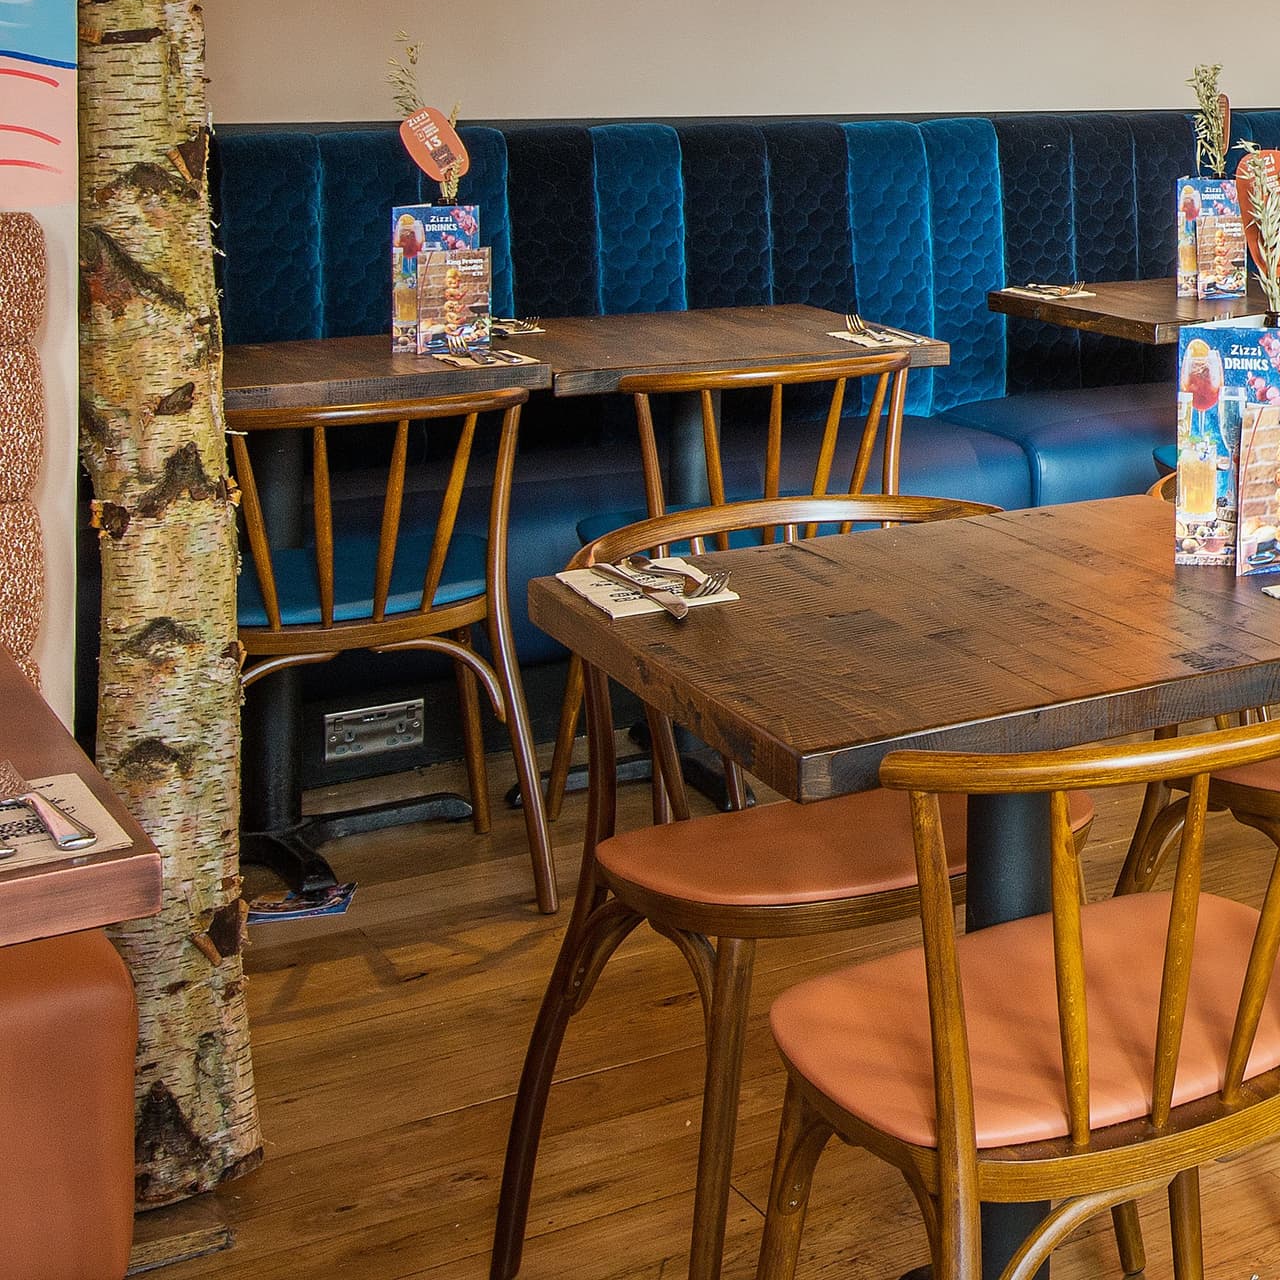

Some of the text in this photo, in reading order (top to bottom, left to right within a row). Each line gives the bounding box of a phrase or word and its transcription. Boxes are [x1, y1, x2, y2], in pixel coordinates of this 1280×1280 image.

[406, 110, 429, 128] Zizzi
[430, 215, 453, 223] Zizzi
[425, 223, 458, 232] DRINKS
[1230, 344, 1262, 357] Zizzi
[1223, 357, 1270, 371] DRINKS
